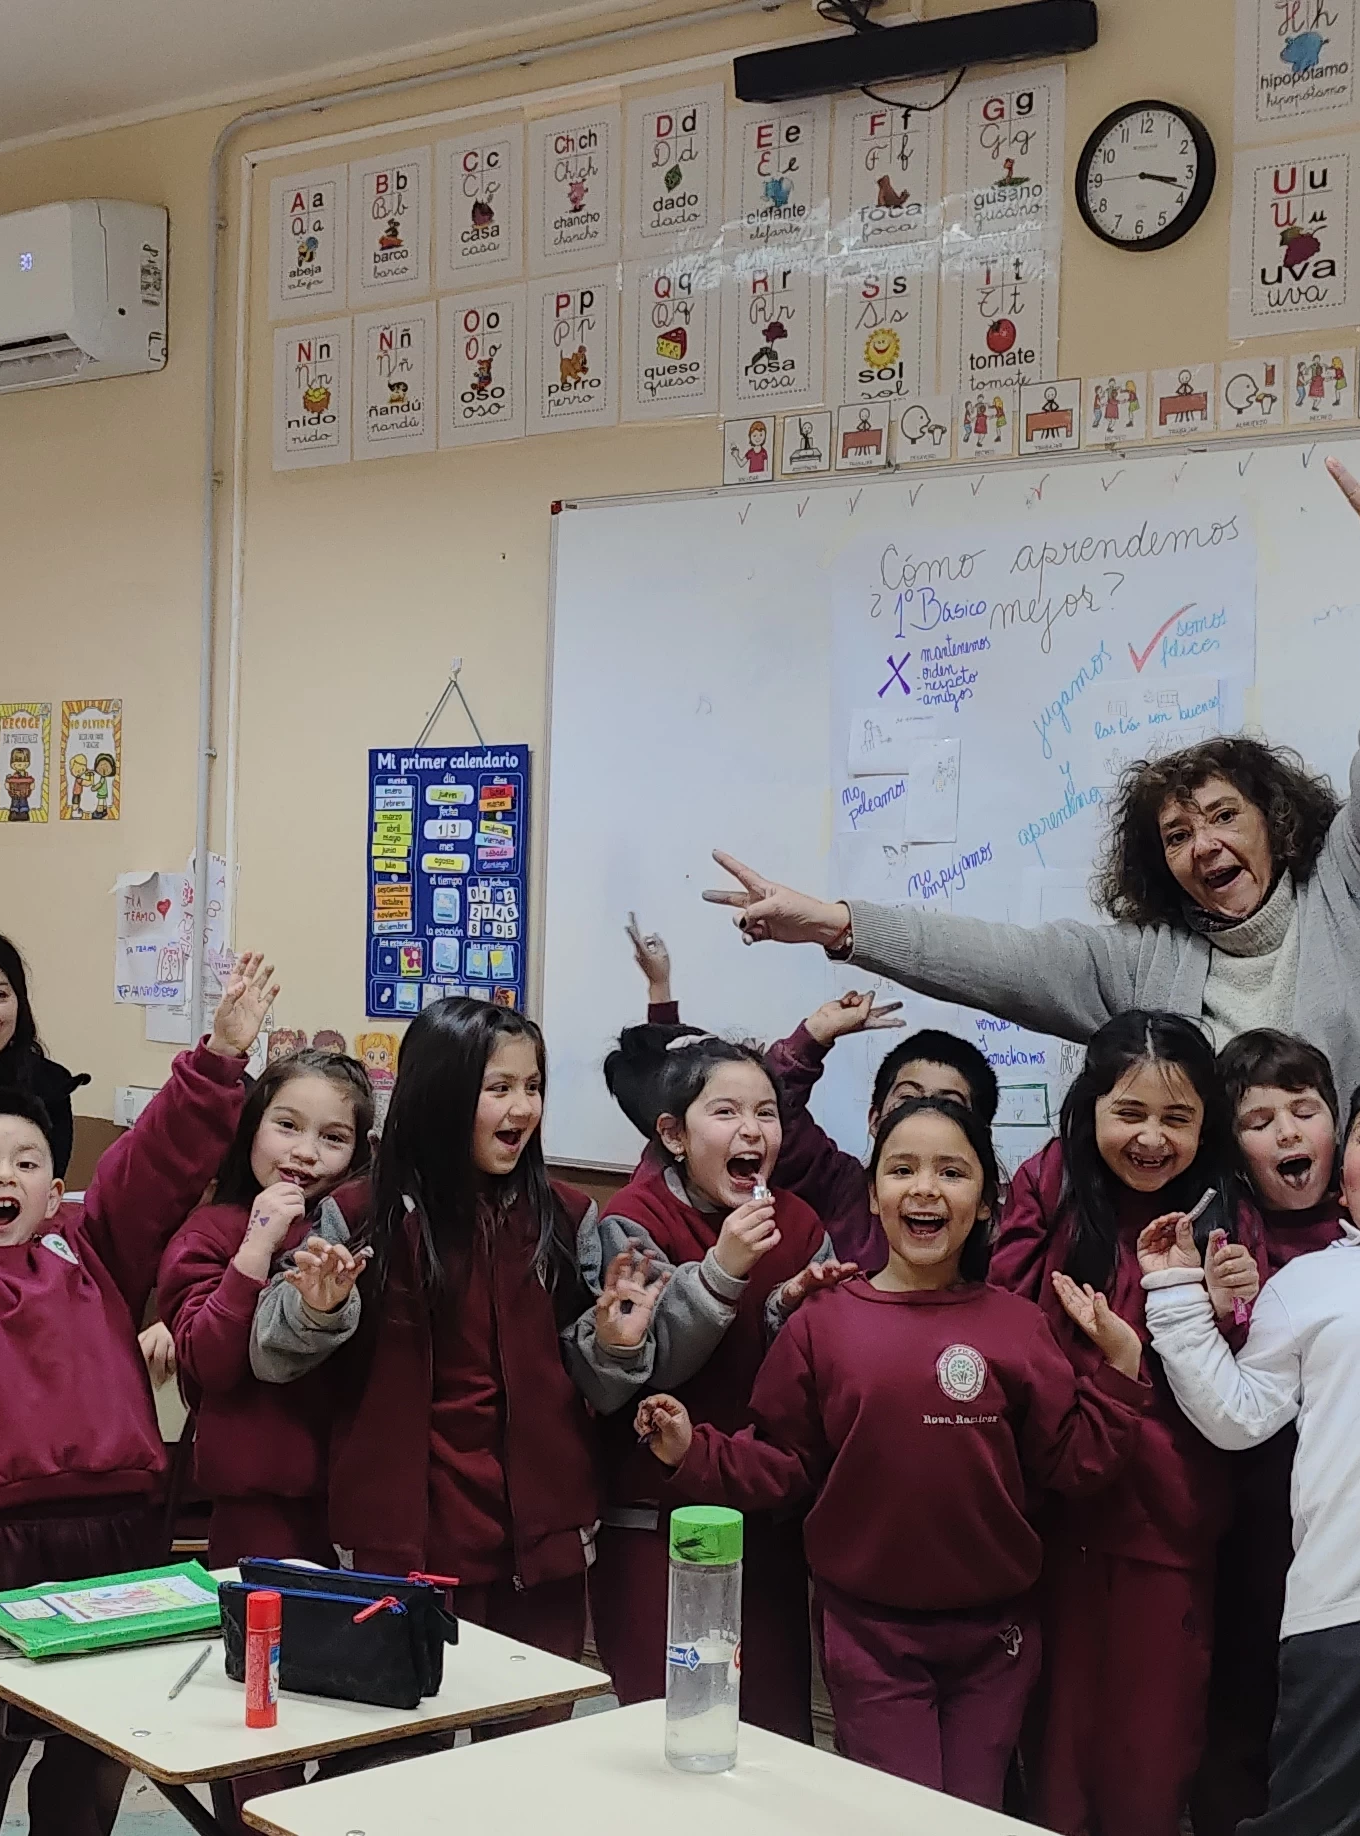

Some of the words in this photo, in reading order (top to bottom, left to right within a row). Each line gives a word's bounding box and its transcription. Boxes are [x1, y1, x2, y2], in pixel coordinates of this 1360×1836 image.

[982, 98, 1006, 121] G
[656, 114, 673, 138] D
[869, 112, 887, 136] F
[1140, 117, 1154, 135] 12
[553, 134, 575, 155] Ch
[578, 128, 598, 150] ch
[756, 124, 774, 149] E
[1120, 127, 1130, 144] 11
[1102, 148, 1116, 165] 10
[1178, 139, 1189, 155] 2
[462, 151, 479, 173] C
[1185, 164, 1194, 180] 3
[375, 173, 389, 195] B
[1093, 173, 1103, 189] 9
[1273, 167, 1297, 195] U
[290, 191, 306, 214] A
[652, 191, 699, 213] dado
[974, 184, 1044, 211] gusano
[1098, 197, 1108, 213] 8
[1175, 191, 1185, 207] 4
[553, 210, 601, 230] chancho
[650, 208, 701, 230] dado
[858, 202, 923, 223] foca
[1114, 214, 1123, 230] 7
[1157, 210, 1168, 227] 5
[460, 224, 501, 244] casa
[1134, 219, 1144, 235] 6
[372, 249, 409, 264] barco
[288, 264, 322, 278] abeja
[752, 269, 769, 294] R
[1260, 258, 1337, 286] uva
[654, 275, 672, 299] Q
[1267, 284, 1330, 308] uva
[554, 293, 571, 318] P
[463, 309, 480, 333] O
[378, 326, 394, 351] Ñ
[297, 340, 312, 363] N
[969, 347, 1036, 371] tomate
[644, 361, 701, 381] queso
[744, 358, 796, 377] rosa
[858, 361, 904, 384] sol
[547, 377, 602, 397] perro
[643, 375, 701, 397] queso
[748, 374, 796, 392] rosa
[860, 380, 910, 401] sol
[459, 385, 506, 404] oso
[368, 398, 422, 418] ñandú
[462, 402, 506, 419] oso
[287, 412, 337, 429] nido
[880, 543, 987, 591] Cómo
[1010, 514, 1240, 602] aprendemos
[1032, 639, 1113, 760] jugamos
[377, 752, 396, 770] Mi
[400, 753, 448, 776] primer
[449, 750, 519, 770] calendario
[842, 786, 860, 806] no
[907, 869, 932, 898] no
